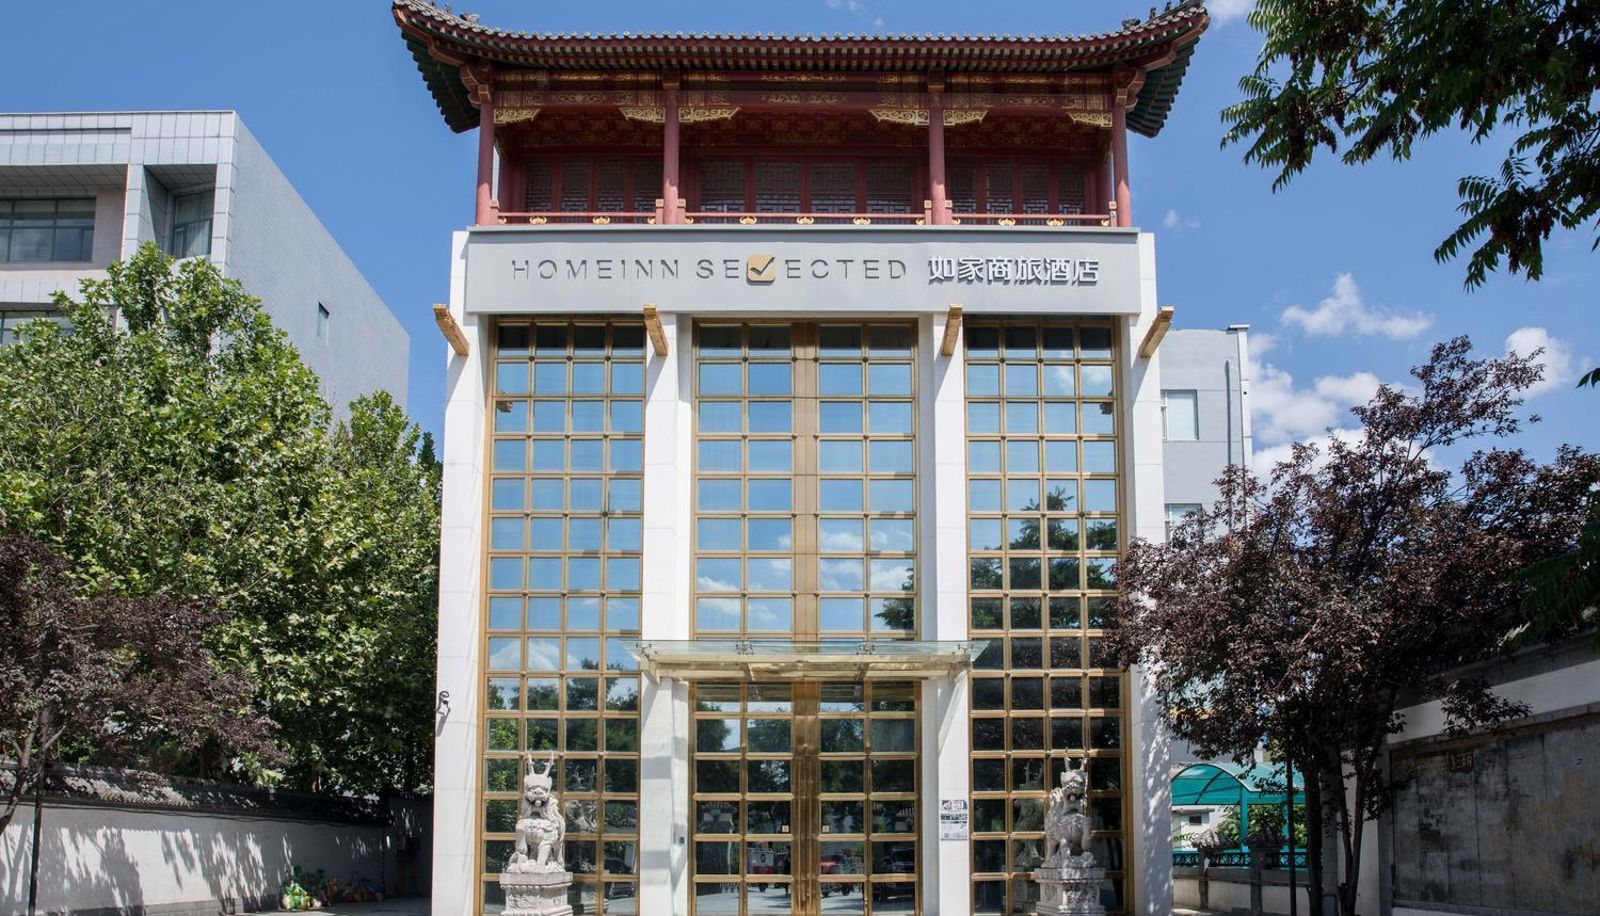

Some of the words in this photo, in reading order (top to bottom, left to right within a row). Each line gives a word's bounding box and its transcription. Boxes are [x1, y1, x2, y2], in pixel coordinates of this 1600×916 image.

[511, 259, 679, 280] HOMEINN
[928, 256, 1099, 285] 如家商旅酒店
